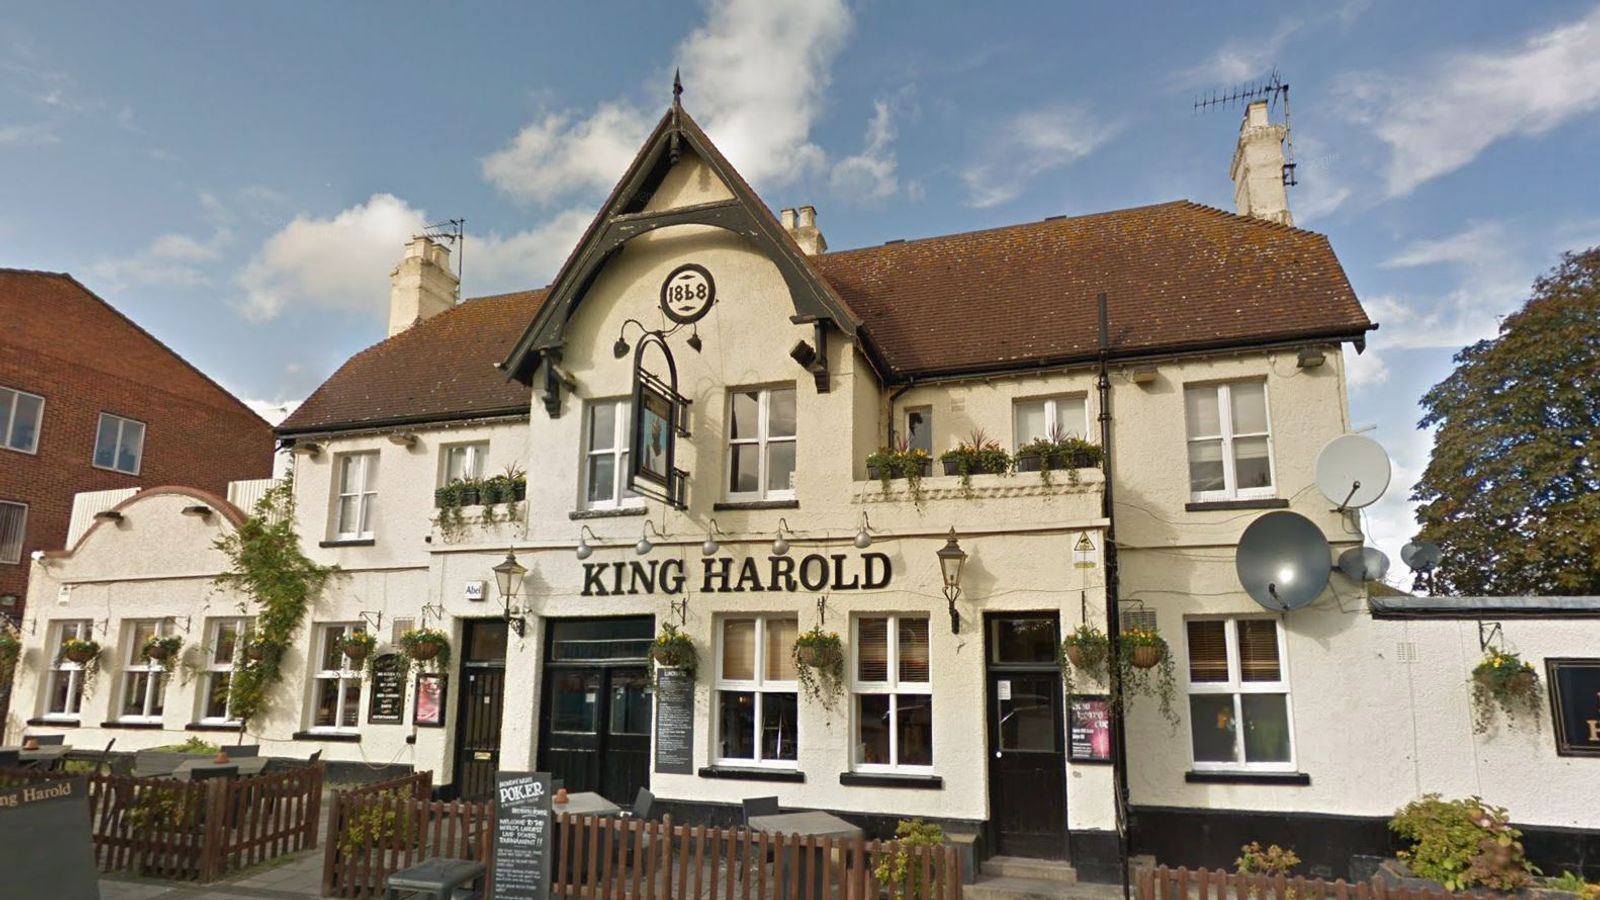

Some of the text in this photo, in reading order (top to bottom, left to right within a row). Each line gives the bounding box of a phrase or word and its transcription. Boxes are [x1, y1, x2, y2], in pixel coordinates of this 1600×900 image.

[668, 283, 706, 303] 1868
[581, 552, 893, 596] KING HAROLD
[23, 782, 72, 803] Harold
[500, 781, 545, 803] POKER
